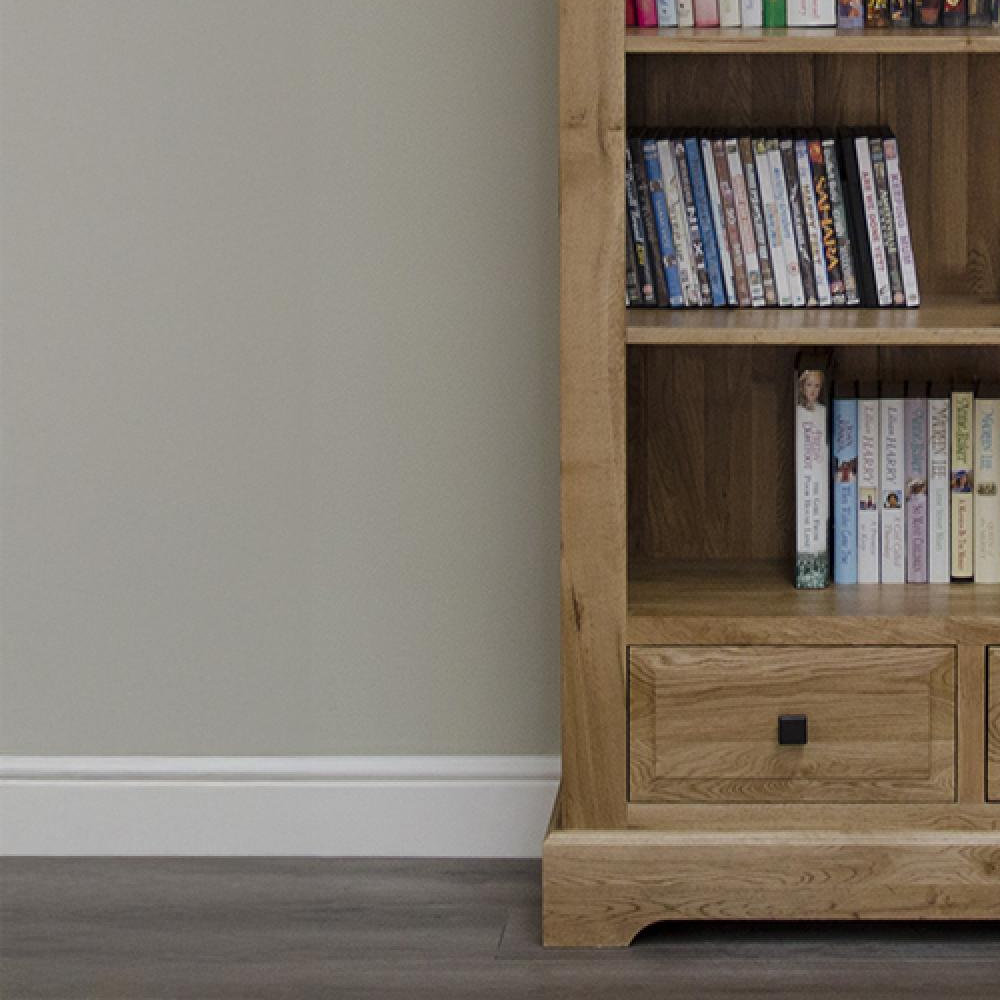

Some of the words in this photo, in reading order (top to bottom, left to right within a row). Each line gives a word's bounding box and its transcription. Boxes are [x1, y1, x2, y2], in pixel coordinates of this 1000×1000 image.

[814, 177, 839, 271] SAHARA
[862, 437, 874, 484] HARRY
[886, 437, 897, 484] HARRY
[931, 461, 946, 480] LEE
